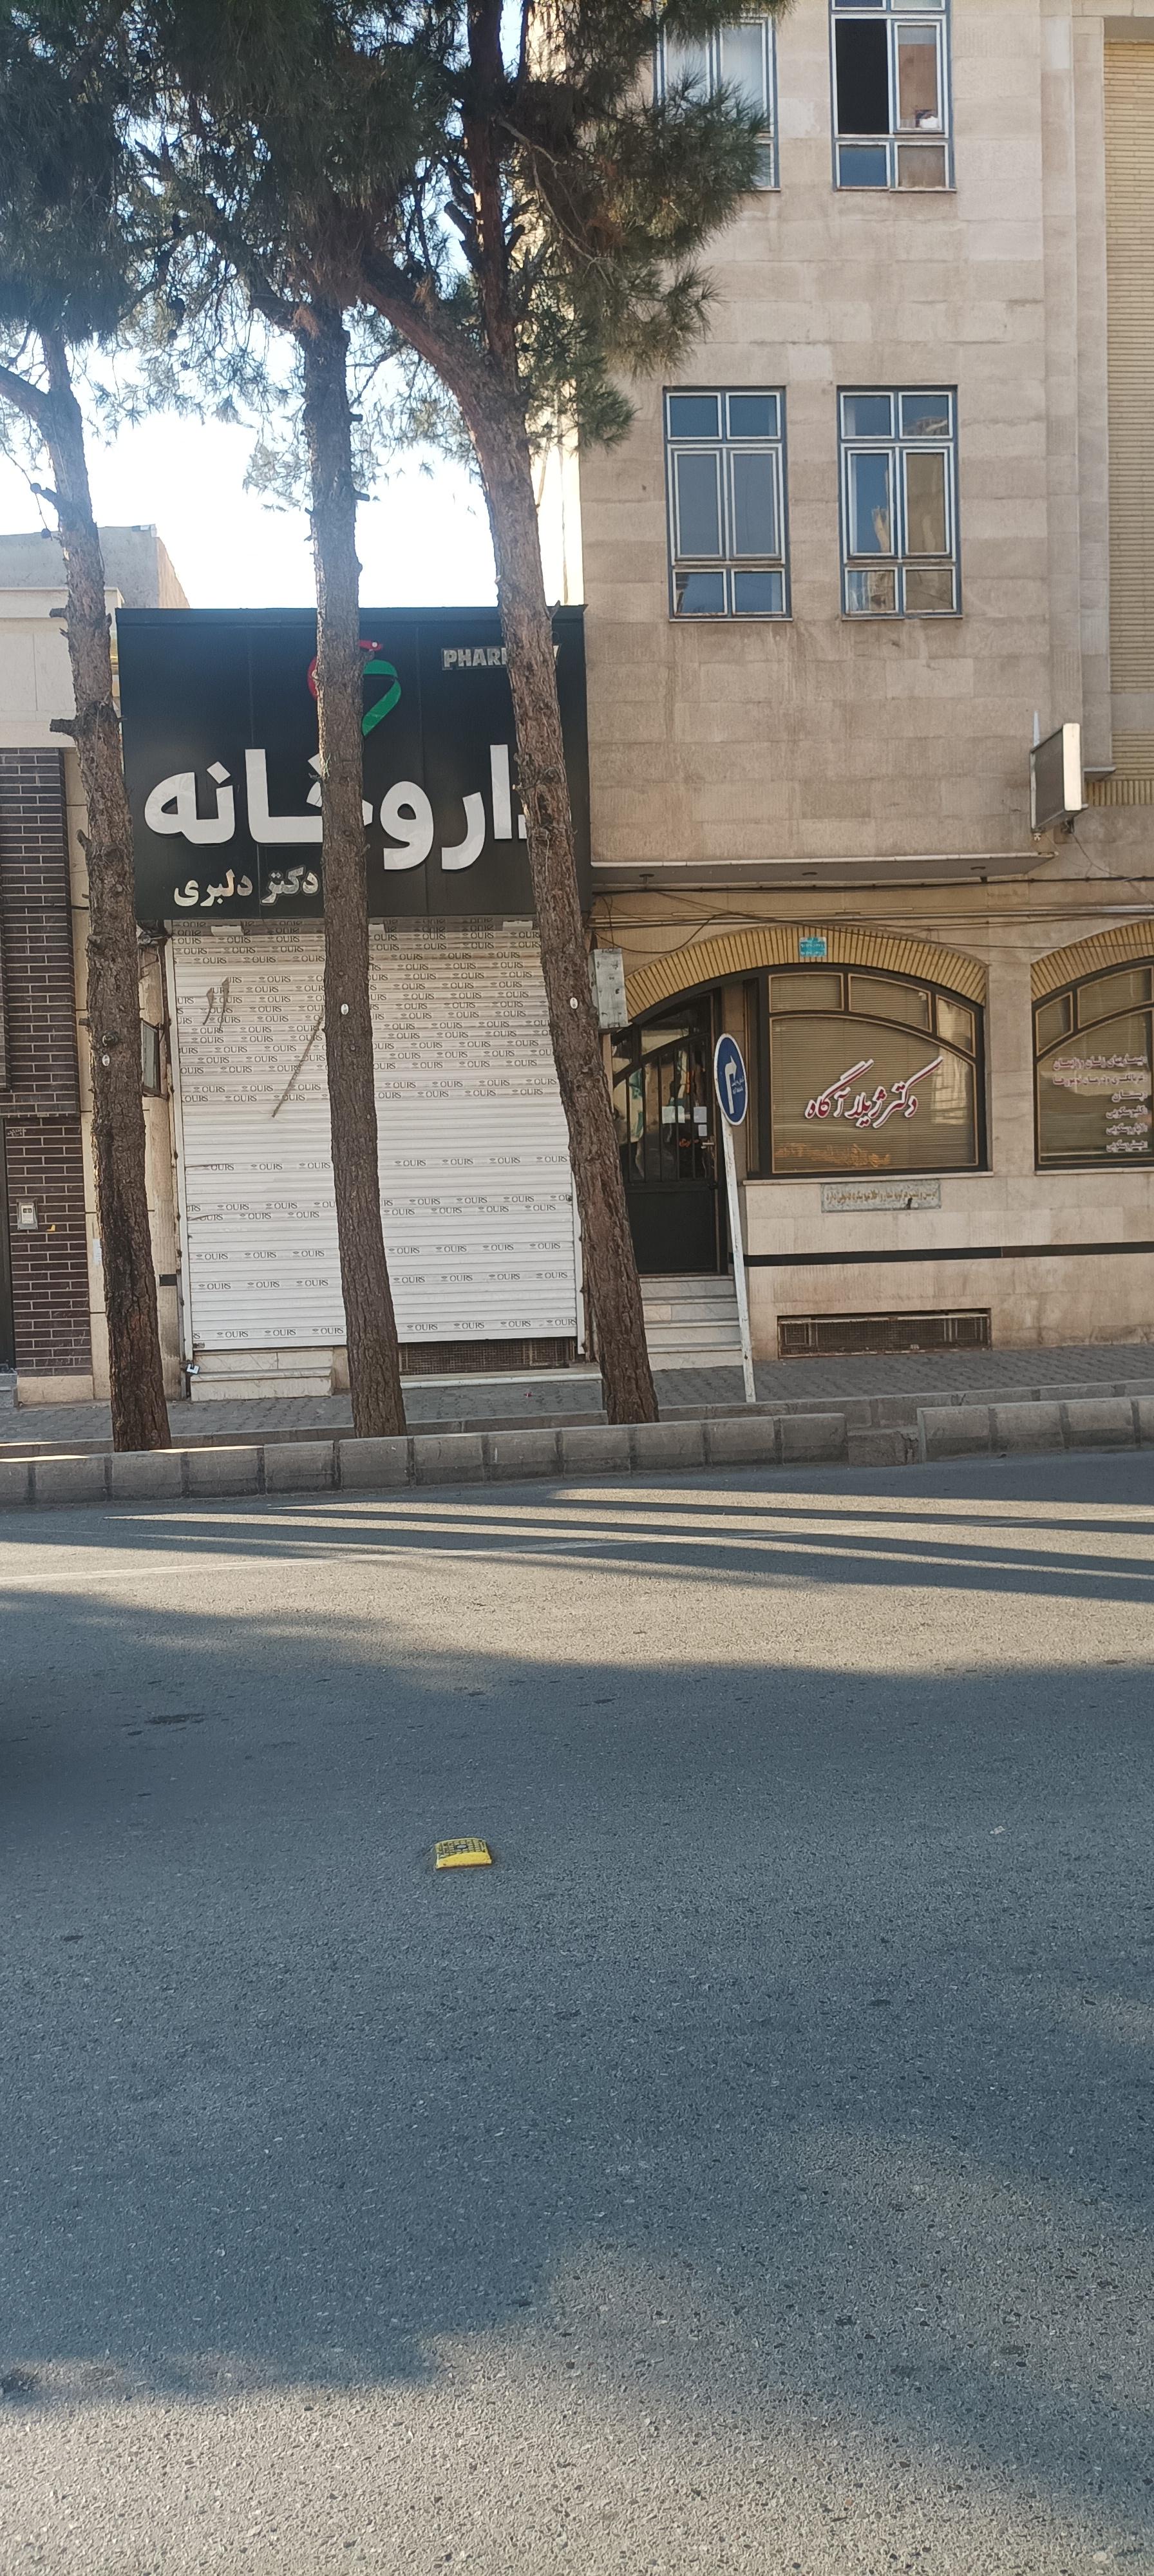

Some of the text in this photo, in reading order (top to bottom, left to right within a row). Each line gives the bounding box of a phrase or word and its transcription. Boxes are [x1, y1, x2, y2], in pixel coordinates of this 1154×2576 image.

[174, 867, 319, 907] دکتر دلبری
[805, 1056, 944, 1128] دکتر ژیلا آگاه
